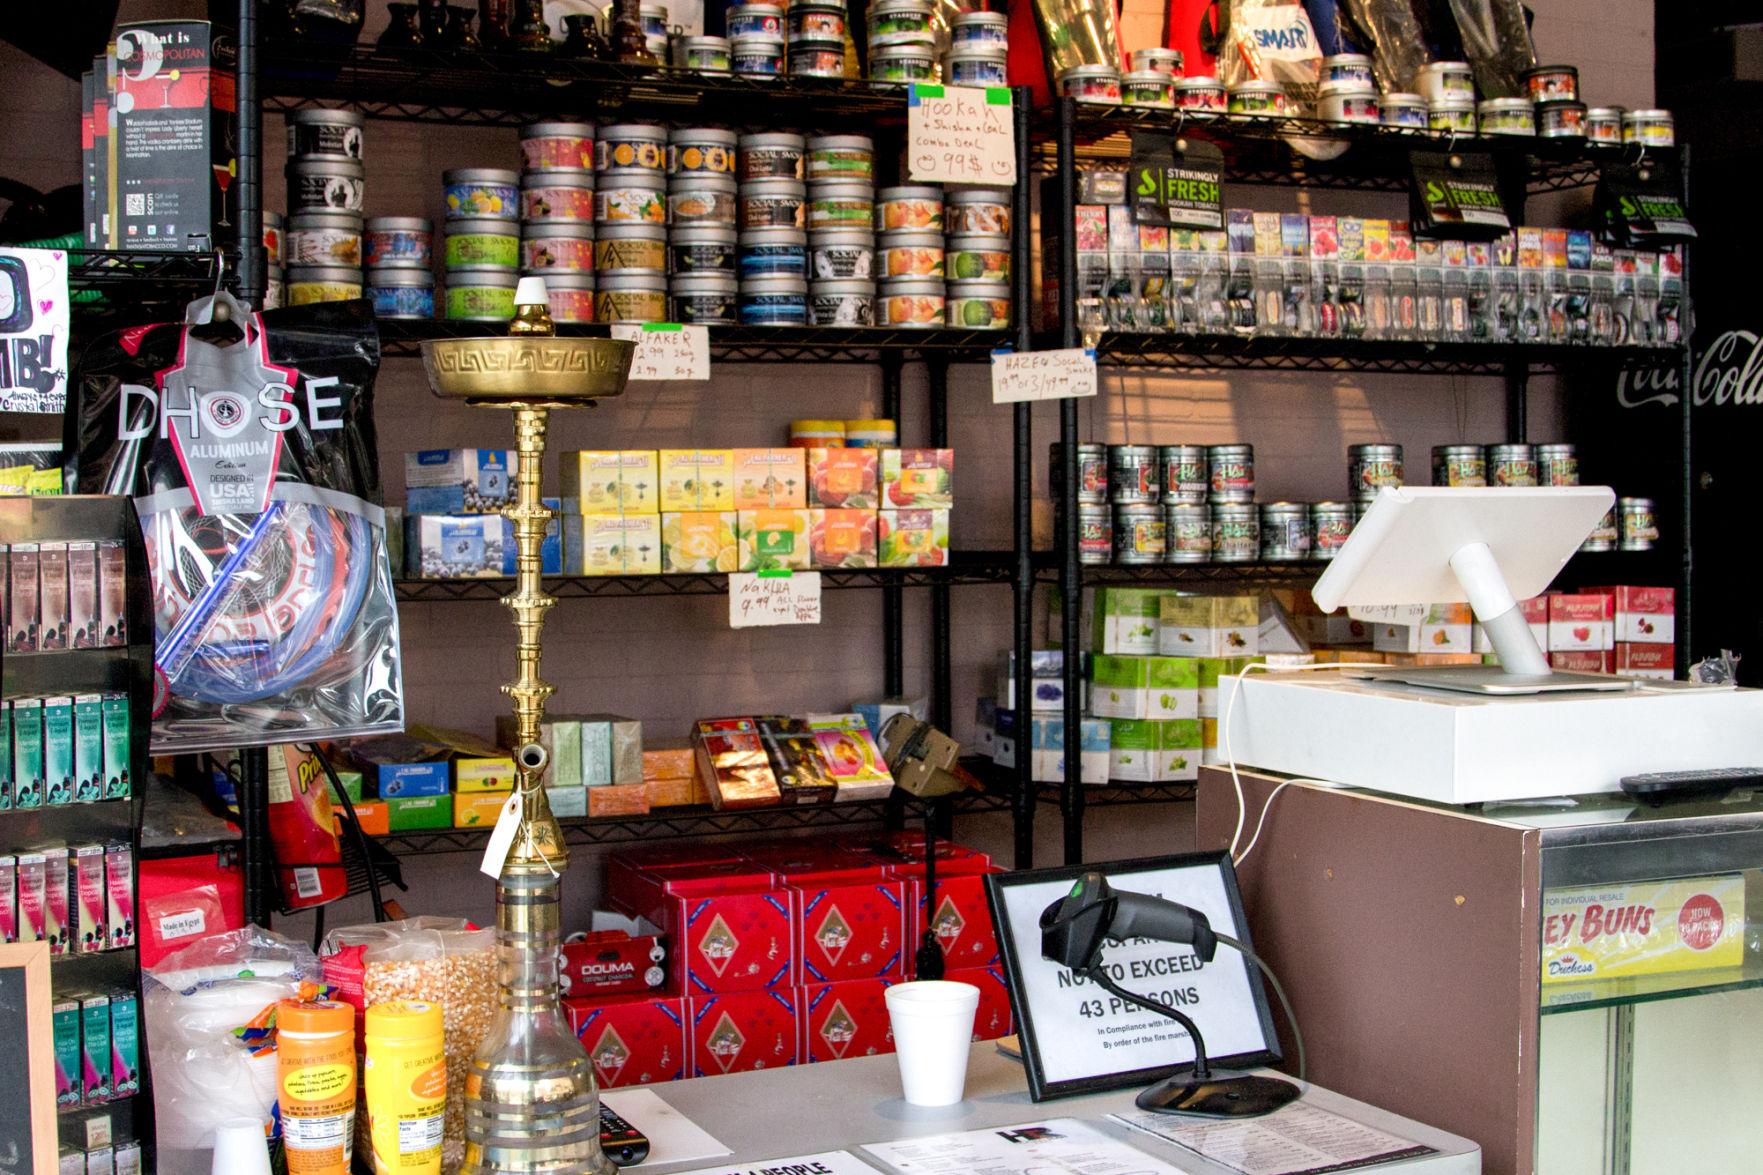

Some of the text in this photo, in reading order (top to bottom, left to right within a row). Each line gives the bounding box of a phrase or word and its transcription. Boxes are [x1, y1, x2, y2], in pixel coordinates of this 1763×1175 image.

[1167, 168, 1219, 182] STRIKINGLY
[1168, 179, 1219, 202] FRESH
[1451, 189, 1500, 207] FRESH
[190, 440, 269, 458] ALUMINUM
[210, 474, 245, 482] DESIGNED
[209, 483, 250, 498] USA
[1546, 892, 1625, 906] FOR INDIVIDUAL RESALE
[163, 923, 178, 931] Made
[185, 919, 200, 930] Egypt
[1543, 904, 1656, 945] EY BUNS
[581, 961, 635, 975] DOUMA
[1132, 953, 1204, 979] EXCEED
[1549, 960, 1595, 976] Duchess
[1080, 1000, 1105, 1018] 43
[1106, 1022, 1147, 1034] Compliance
[1148, 1019, 1163, 1028] with
[1164, 1018, 1176, 1026] fire
[1103, 1041, 1112, 1049] By
[1113, 1038, 1132, 1047] order
[1142, 1035, 1153, 1043] the
[1154, 1033, 1167, 1041] fire
[1167, 1030, 1191, 1039] marsh
